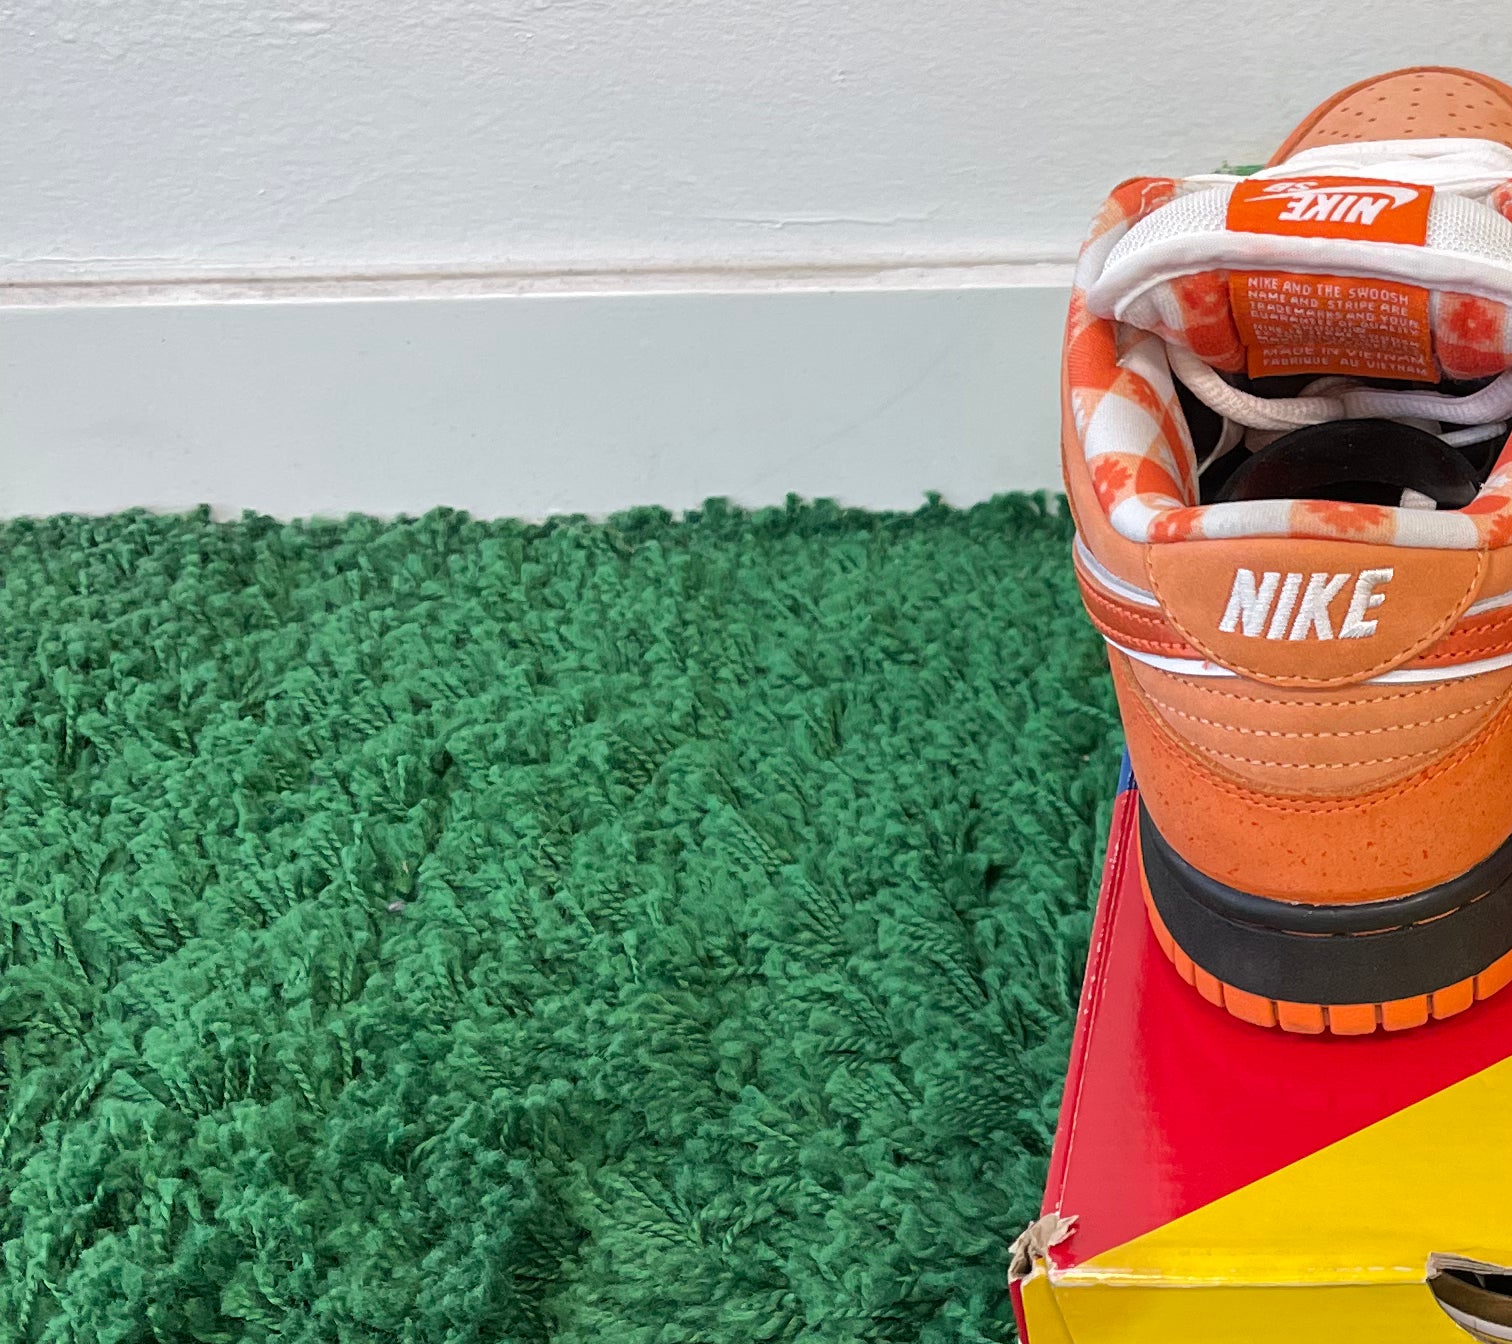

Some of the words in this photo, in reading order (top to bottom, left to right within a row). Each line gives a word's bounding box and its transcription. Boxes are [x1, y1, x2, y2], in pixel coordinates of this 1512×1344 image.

[1278, 193, 1390, 225] NIKE
[1248, 277, 1278, 290] NIKE
[1282, 281, 1312, 295] AND
[1317, 284, 1341, 298] THE
[1348, 286, 1409, 306] SWOOSH
[1248, 290, 1286, 303] NAME
[1290, 296, 1318, 308] AND
[1327, 299, 1375, 311] STRIPE
[1380, 302, 1408, 316] ARE
[1380, 314, 1419, 329] YOUR
[1321, 346, 1340, 356] IN
[1346, 348, 1425, 365] VIETNAM
[1218, 568, 1394, 641] NIKE
